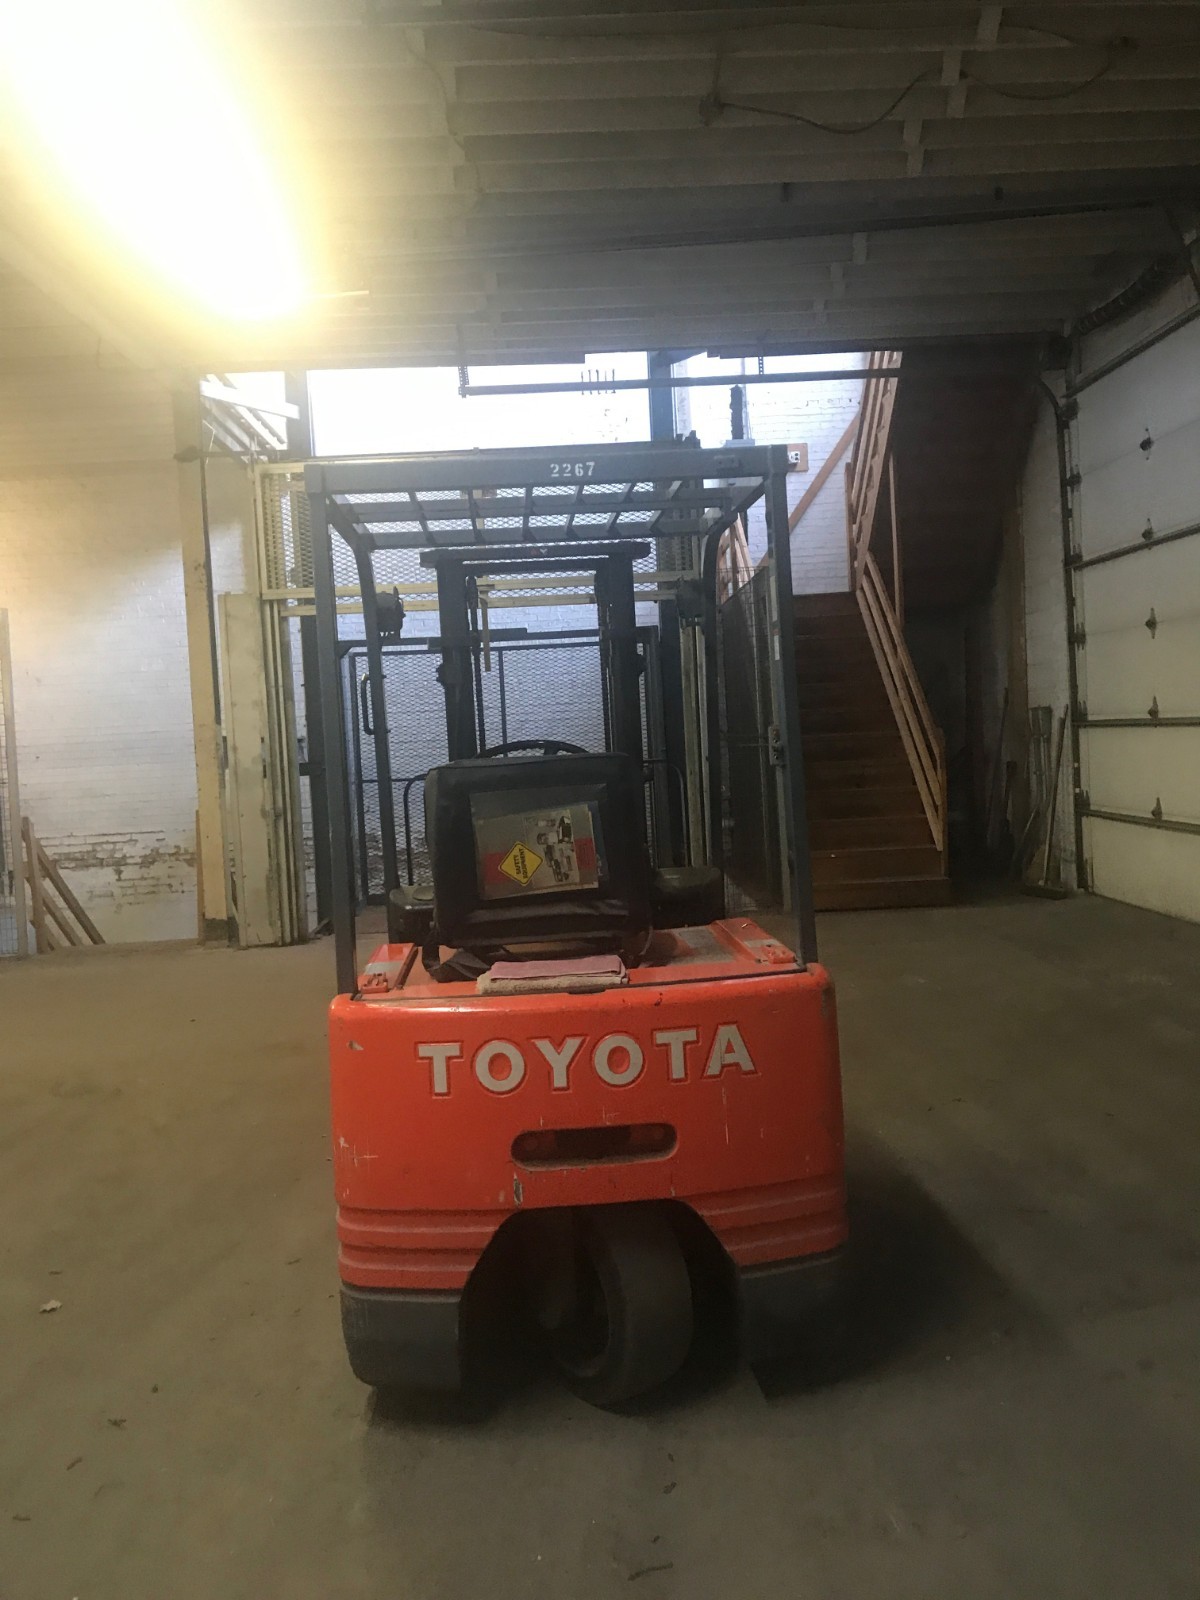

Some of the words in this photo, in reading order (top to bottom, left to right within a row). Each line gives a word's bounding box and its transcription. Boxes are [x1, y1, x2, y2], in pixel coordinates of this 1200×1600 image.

[549, 461, 596, 477] 2267
[513, 854, 522, 875] SAFETY
[416, 1023, 760, 1096] TOYOTA
